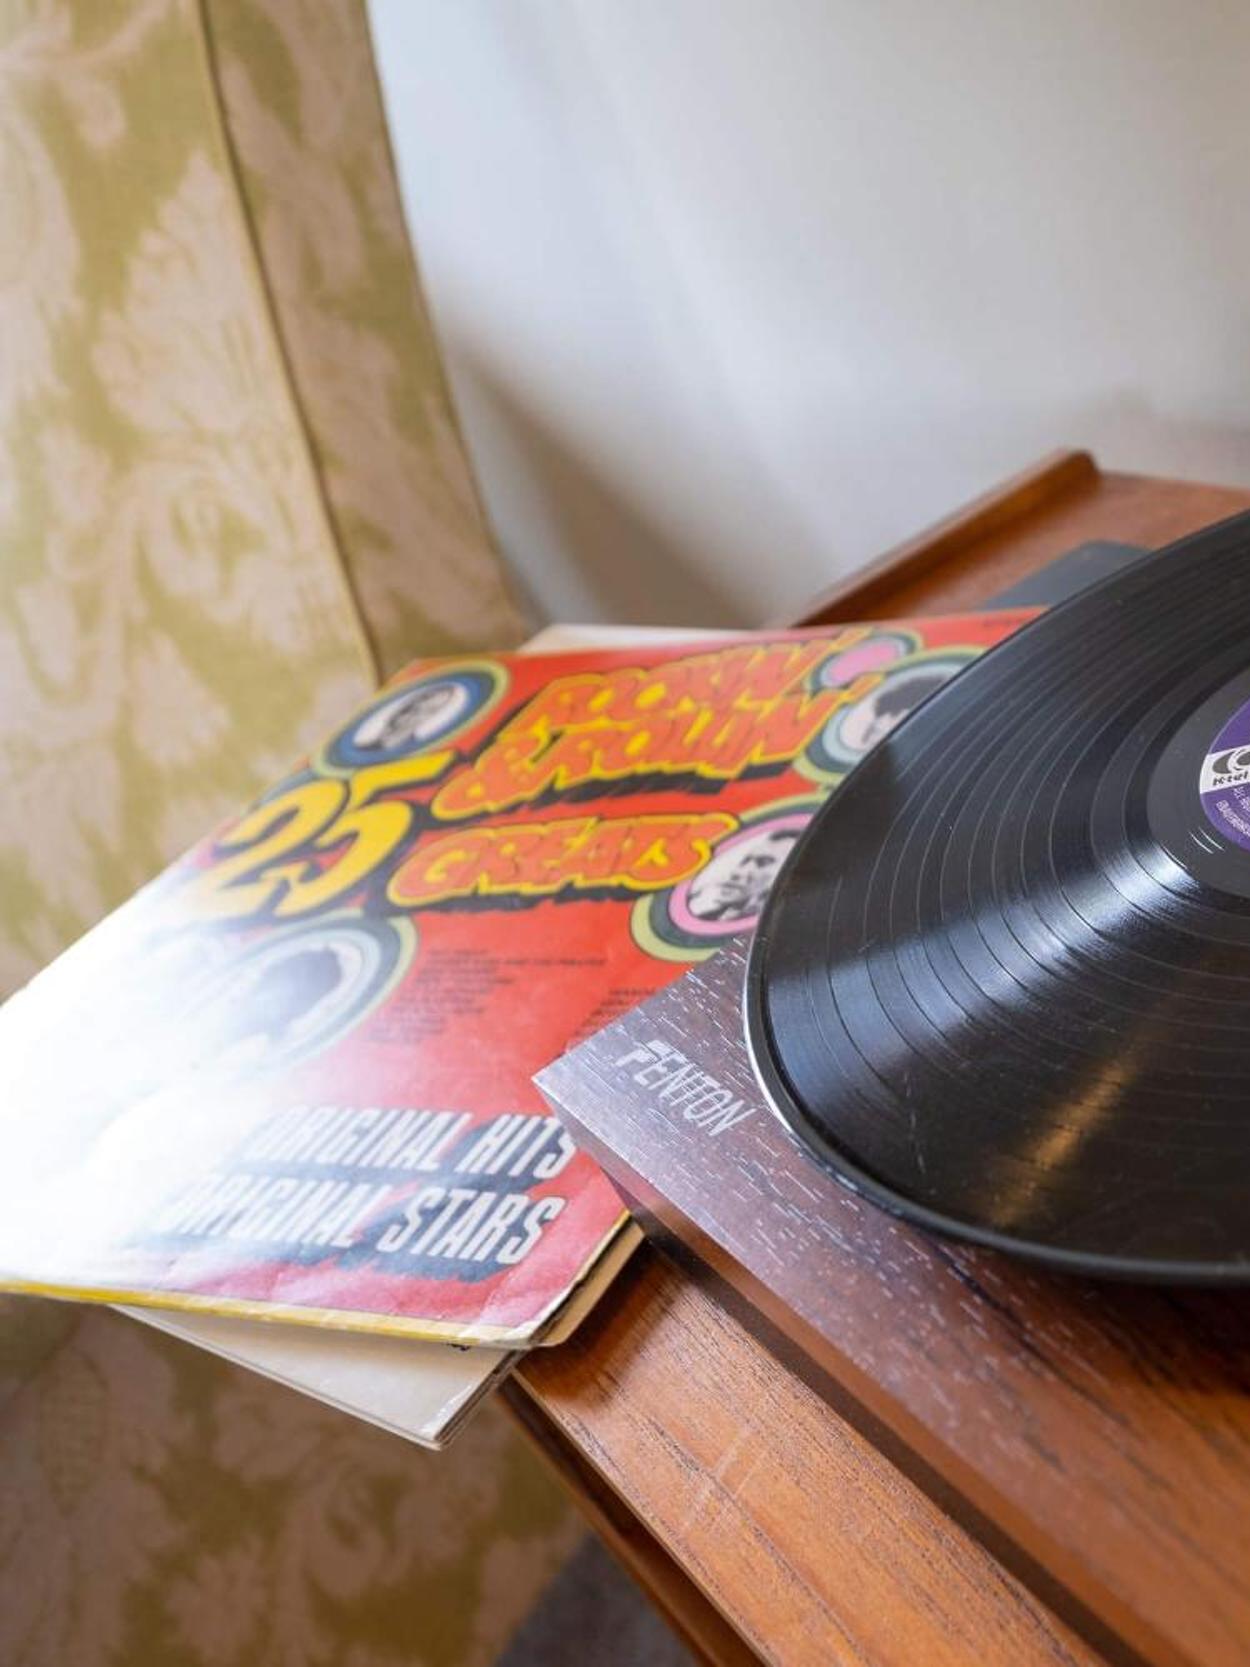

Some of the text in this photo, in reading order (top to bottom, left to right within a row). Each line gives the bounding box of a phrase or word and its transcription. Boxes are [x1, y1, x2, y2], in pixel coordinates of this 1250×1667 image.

[188, 750, 455, 917] 25
[389, 813, 736, 906] GREATS
[615, 1039, 757, 1137] FENTON
[242, 1105, 578, 1180] ORIGINAL HITS
[376, 1185, 568, 1265] STARS
